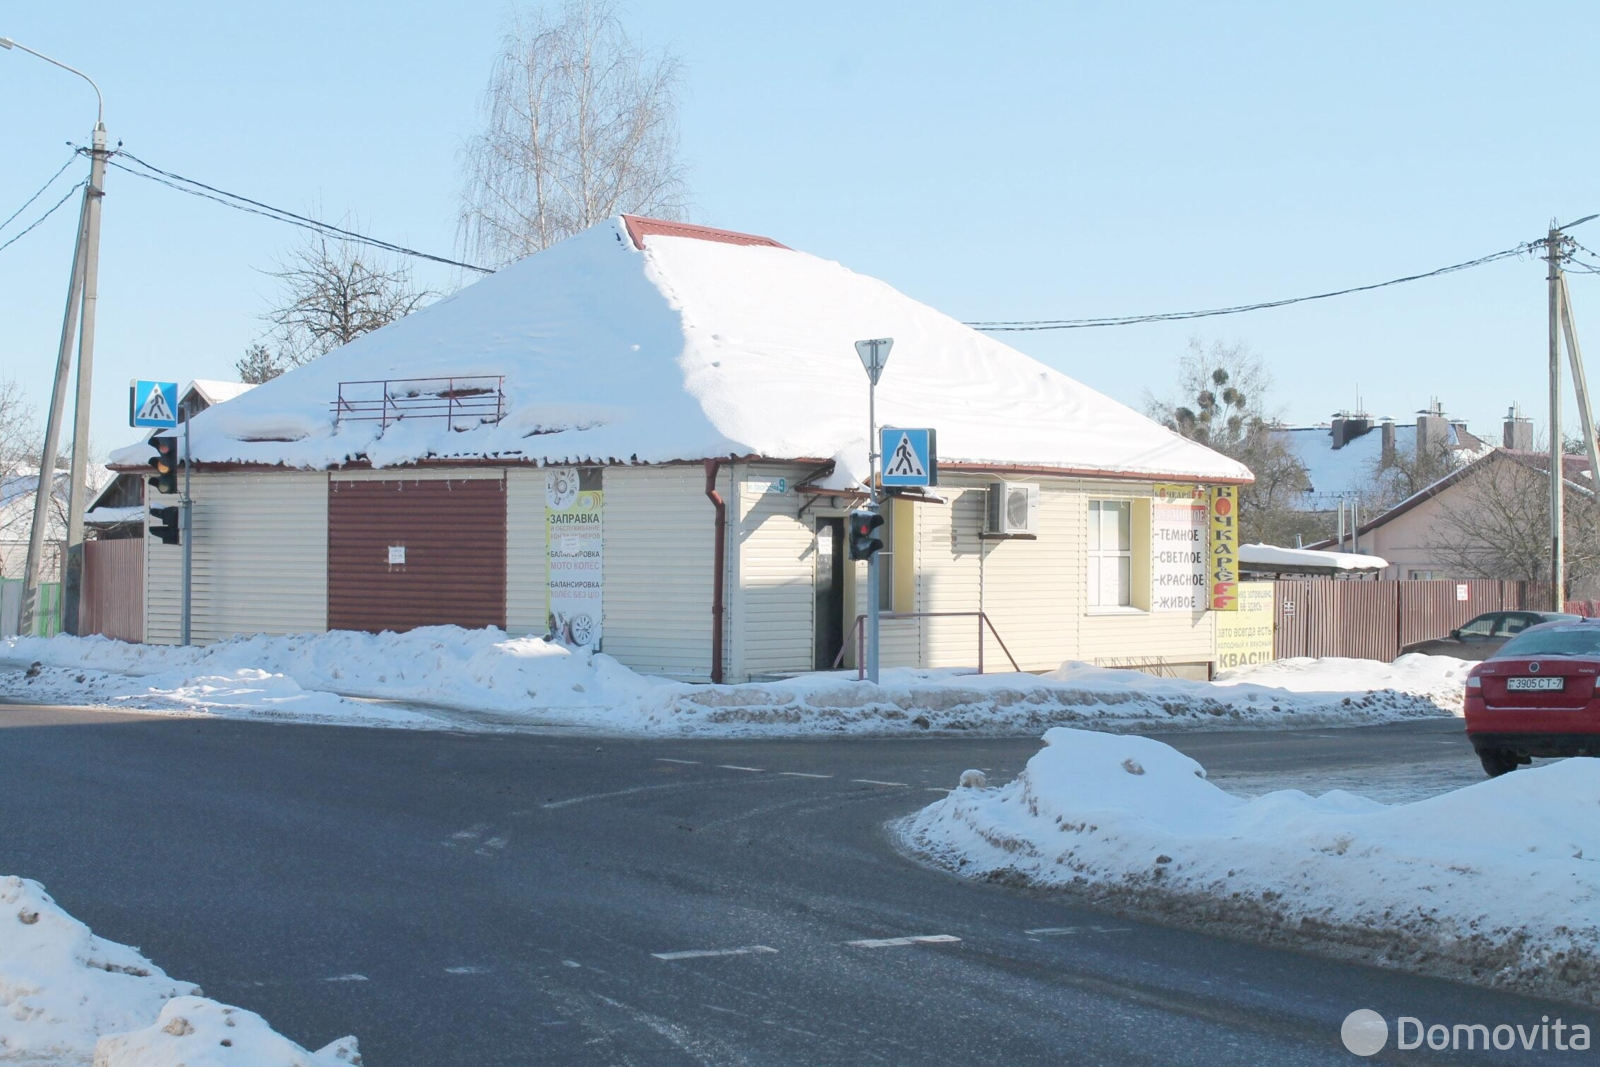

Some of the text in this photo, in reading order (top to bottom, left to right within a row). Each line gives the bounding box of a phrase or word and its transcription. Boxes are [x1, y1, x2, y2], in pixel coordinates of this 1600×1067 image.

[779, 479, 785, 492] 9
[550, 513, 600, 524] ЗАПРАВКА
[550, 561, 572, 570] МОТО
[573, 590, 586, 598] БЕЗ
[1217, 626, 1272, 639] зато всегда есть
[1219, 651, 1270, 668] КВАС!!!
[1516, 678, 1537, 689] 3905
